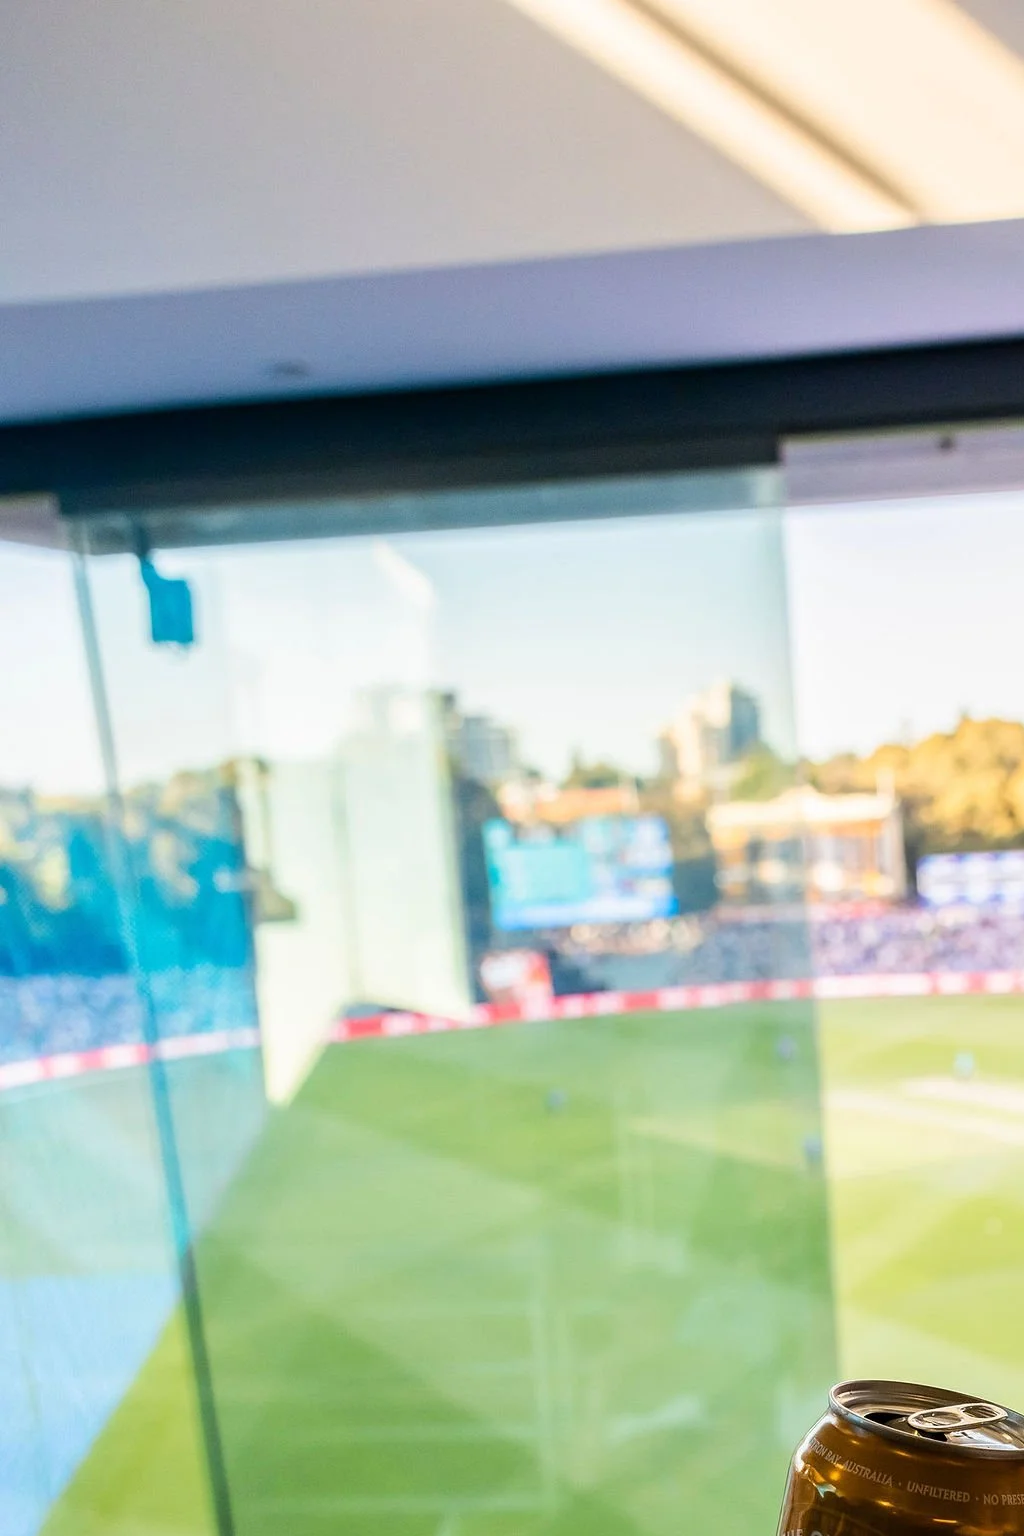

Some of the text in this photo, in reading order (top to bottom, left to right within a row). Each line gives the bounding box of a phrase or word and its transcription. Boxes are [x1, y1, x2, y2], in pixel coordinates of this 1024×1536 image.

[842, 1459, 893, 1488] AUSTRALIA
[906, 1480, 971, 1503] UNFILTERED
[983, 1493, 999, 1506] NO
